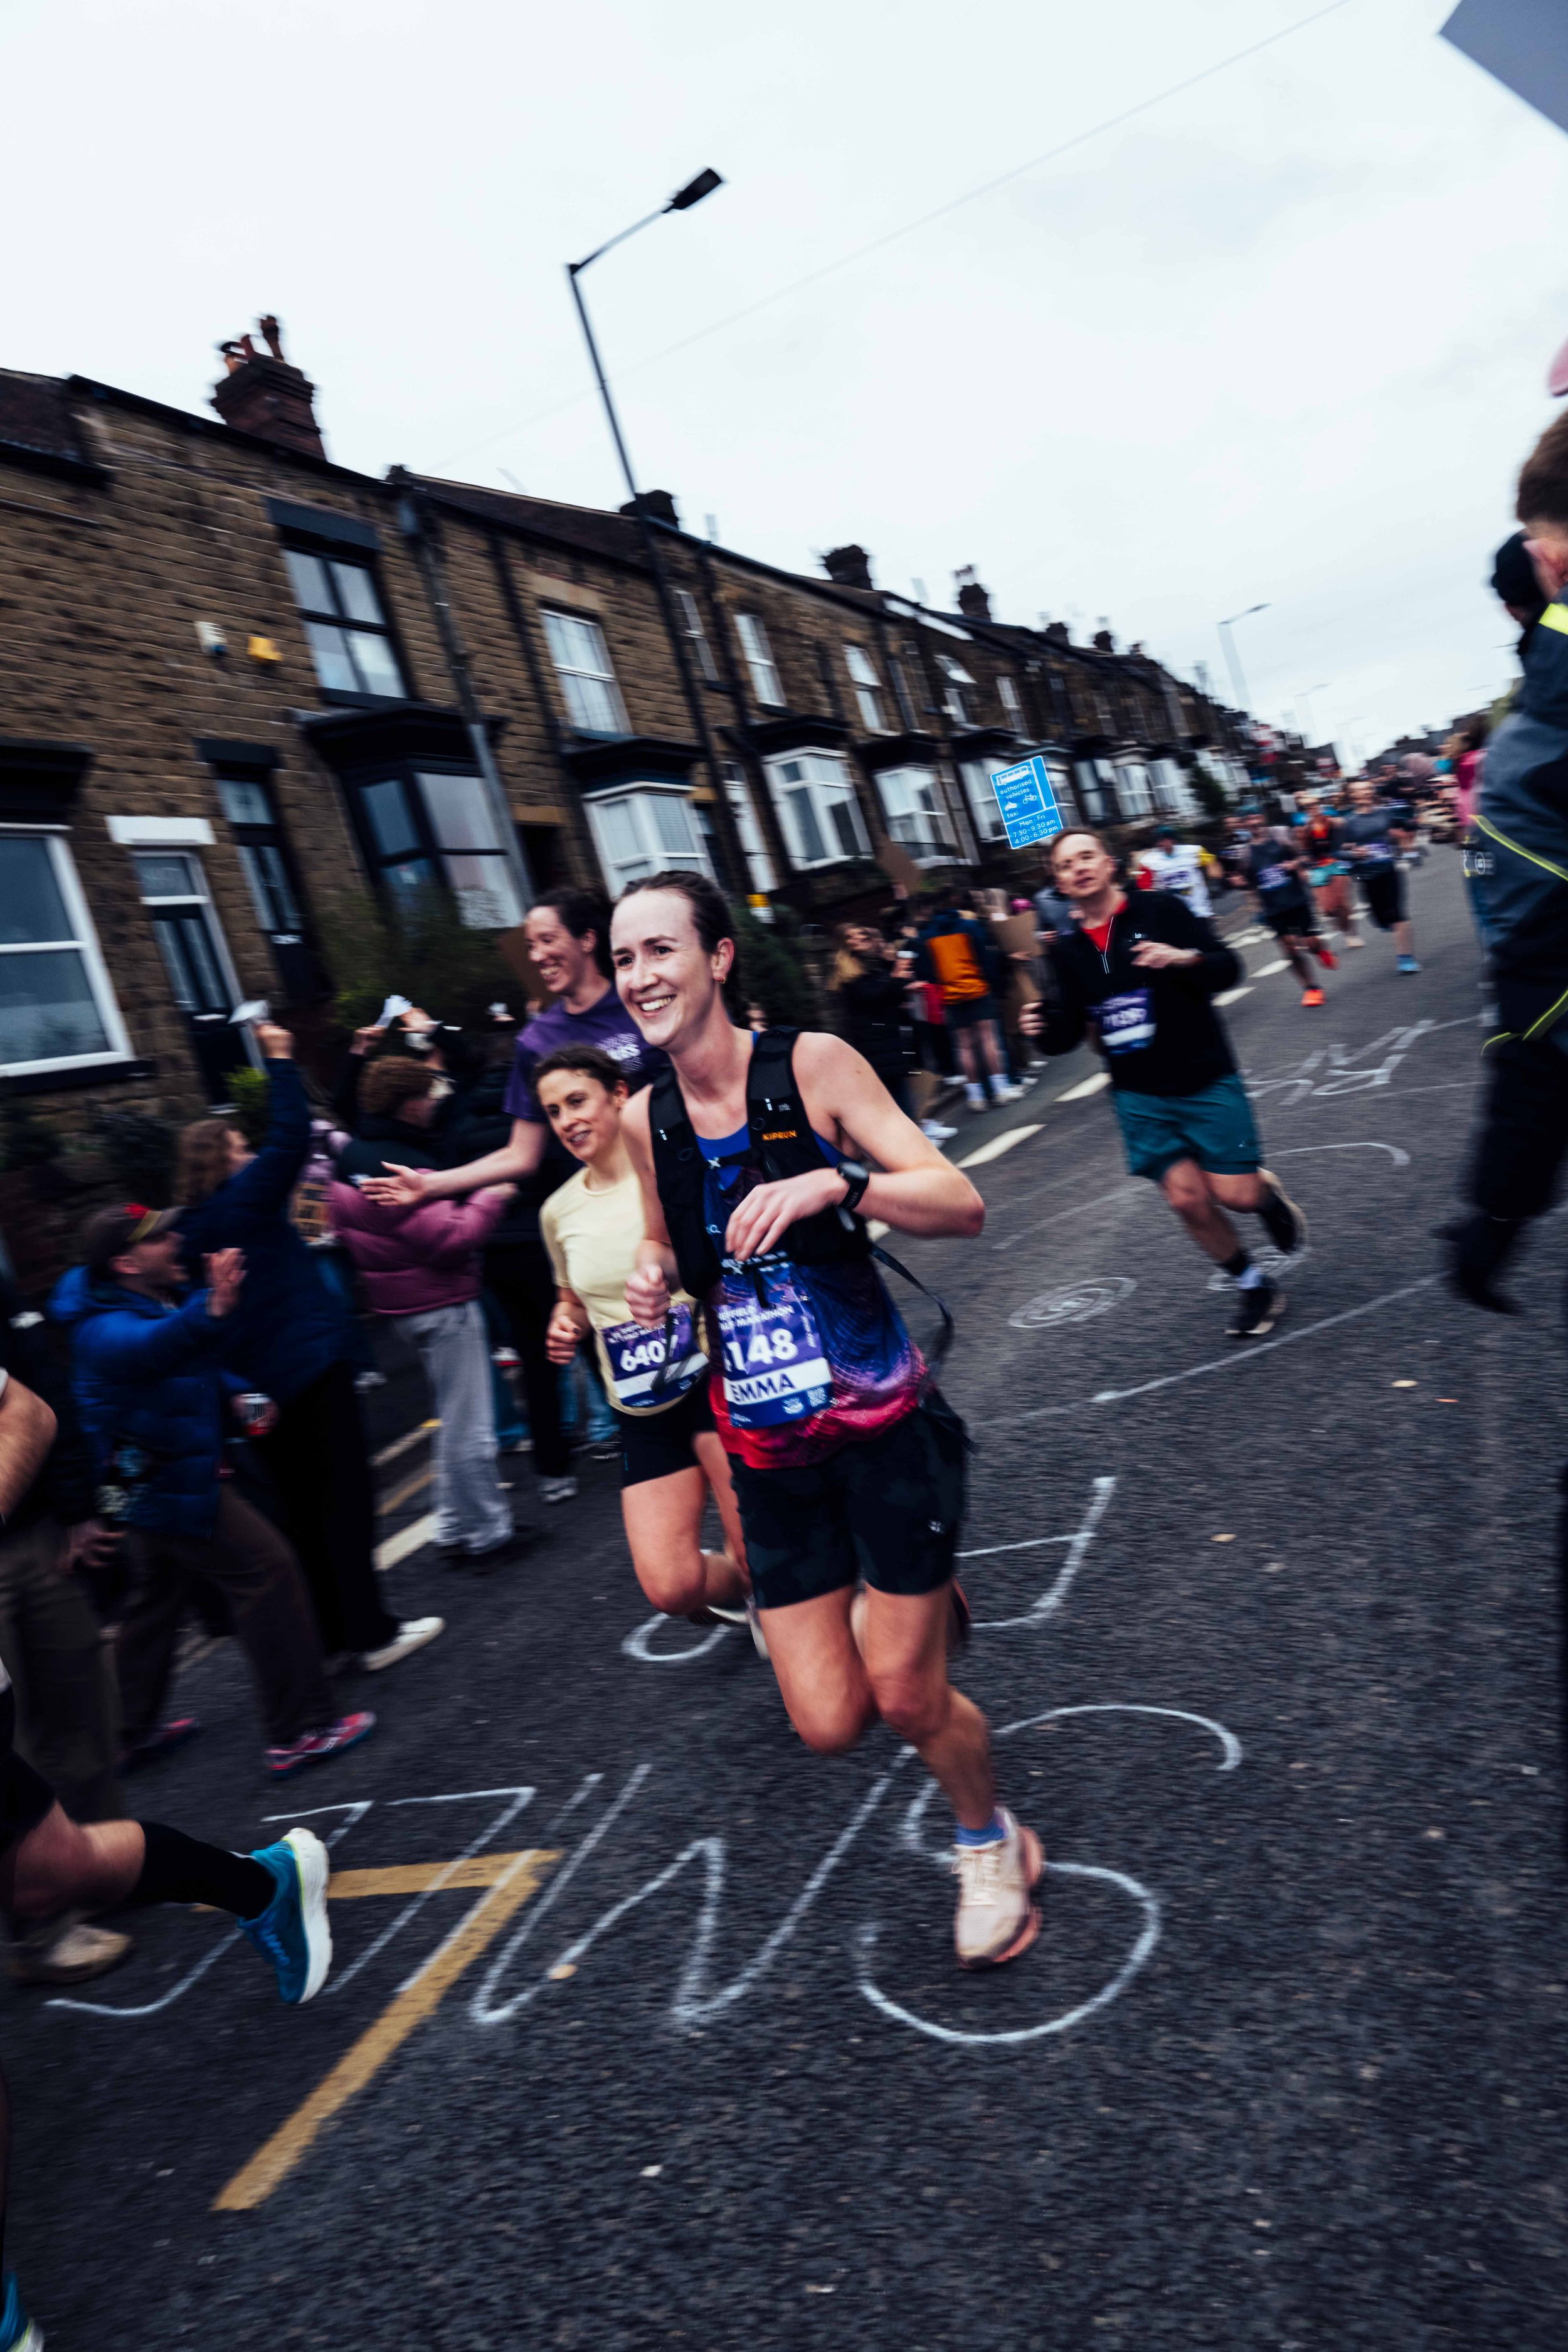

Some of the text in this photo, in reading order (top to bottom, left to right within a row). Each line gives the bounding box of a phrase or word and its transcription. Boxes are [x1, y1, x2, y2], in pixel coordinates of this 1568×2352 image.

[1000, 779, 1032, 795] authorised
[1005, 788, 1030, 799] vehicles
[1019, 819, 1033, 827] Mon
[1030, 822, 1046, 831] 9.30
[1015, 835, 1029, 844] 4.00
[1033, 828, 1047, 837] 6.30
[1048, 825, 1058, 834] pm
[762, 1130, 797, 1141] KIPRUN
[718, 1305, 757, 1322] EFFIELD
[737, 1305, 795, 1327] MARATHON
[729, 1372, 797, 1402] EMMA
